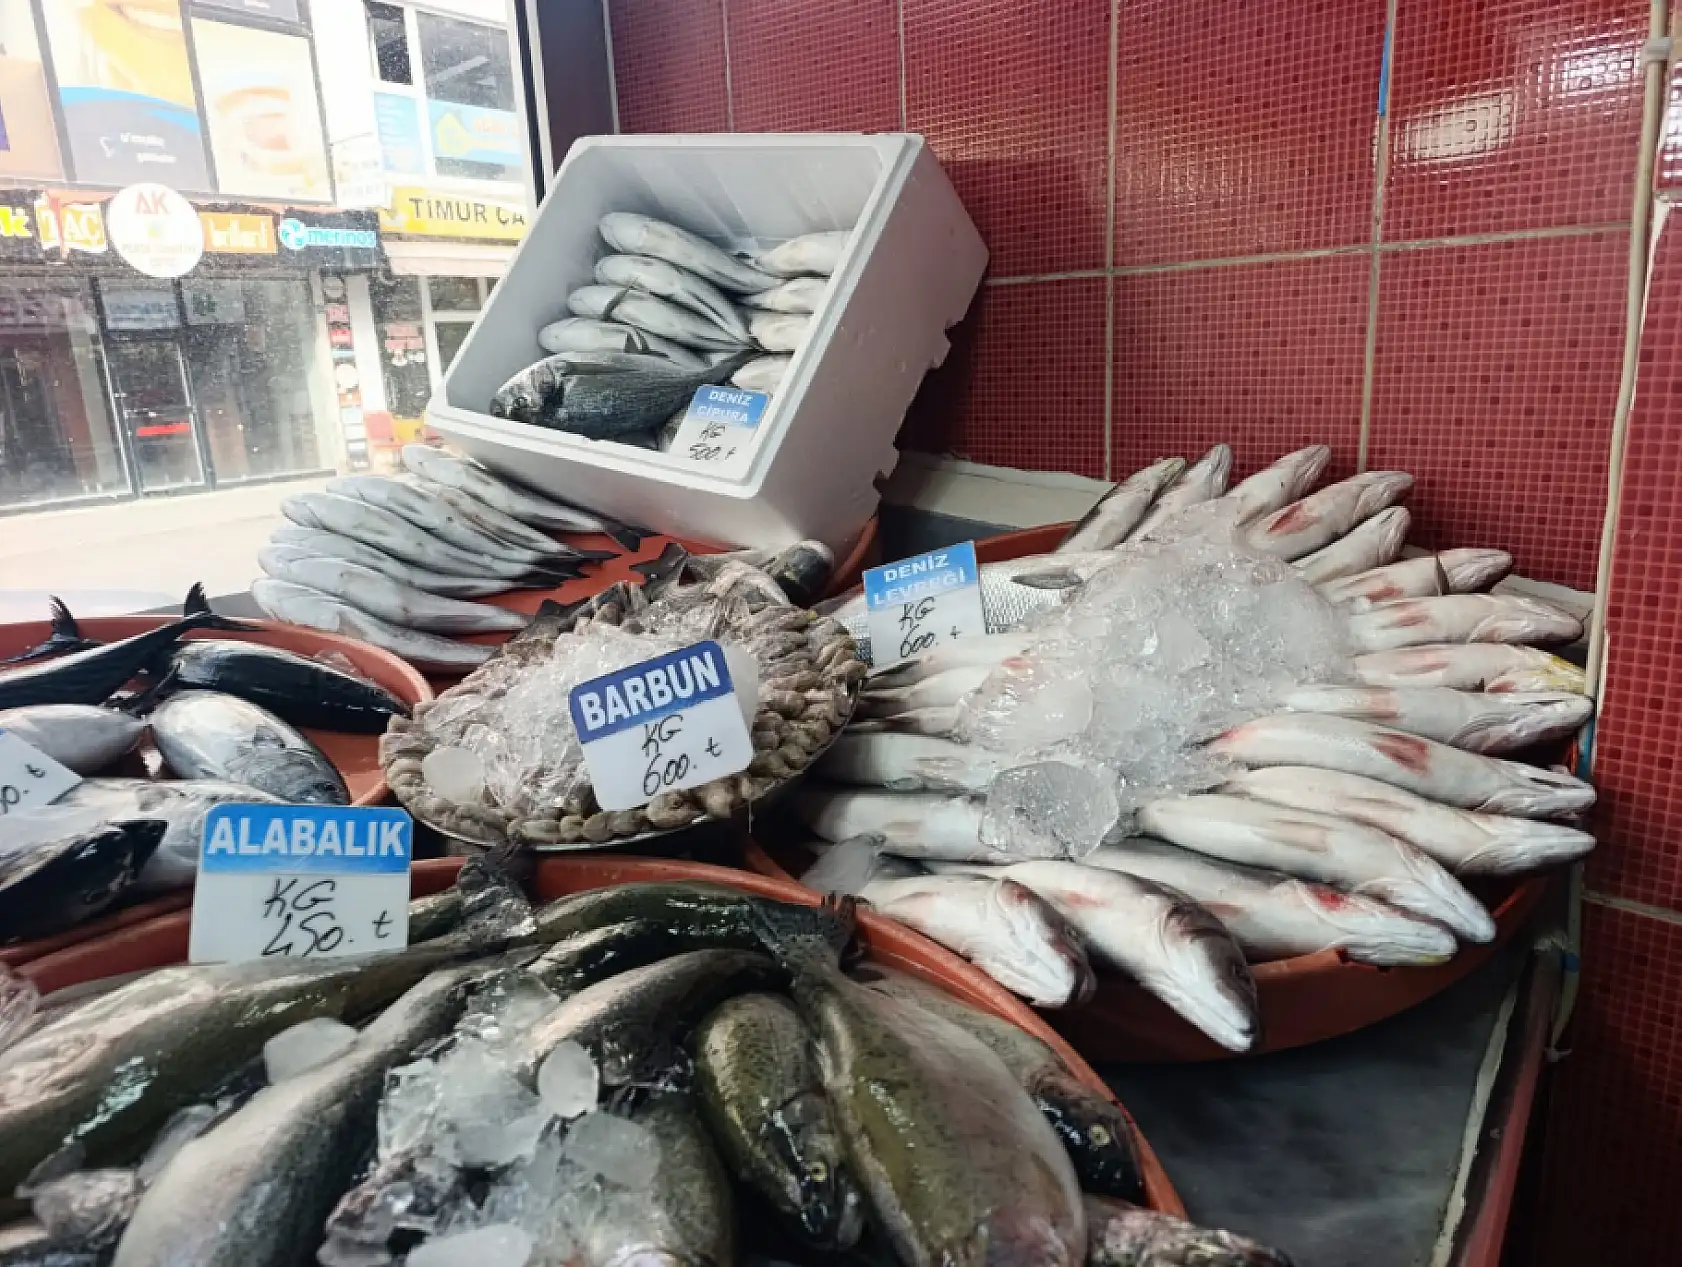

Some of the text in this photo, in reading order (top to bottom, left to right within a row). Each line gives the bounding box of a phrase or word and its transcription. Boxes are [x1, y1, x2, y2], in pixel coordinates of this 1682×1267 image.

[899, 596, 936, 631] KG
[578, 650, 721, 731] BARBUN
[642, 713, 684, 758] KG
[206, 817, 406, 857] ALABALIK
[262, 878, 337, 919] KG
